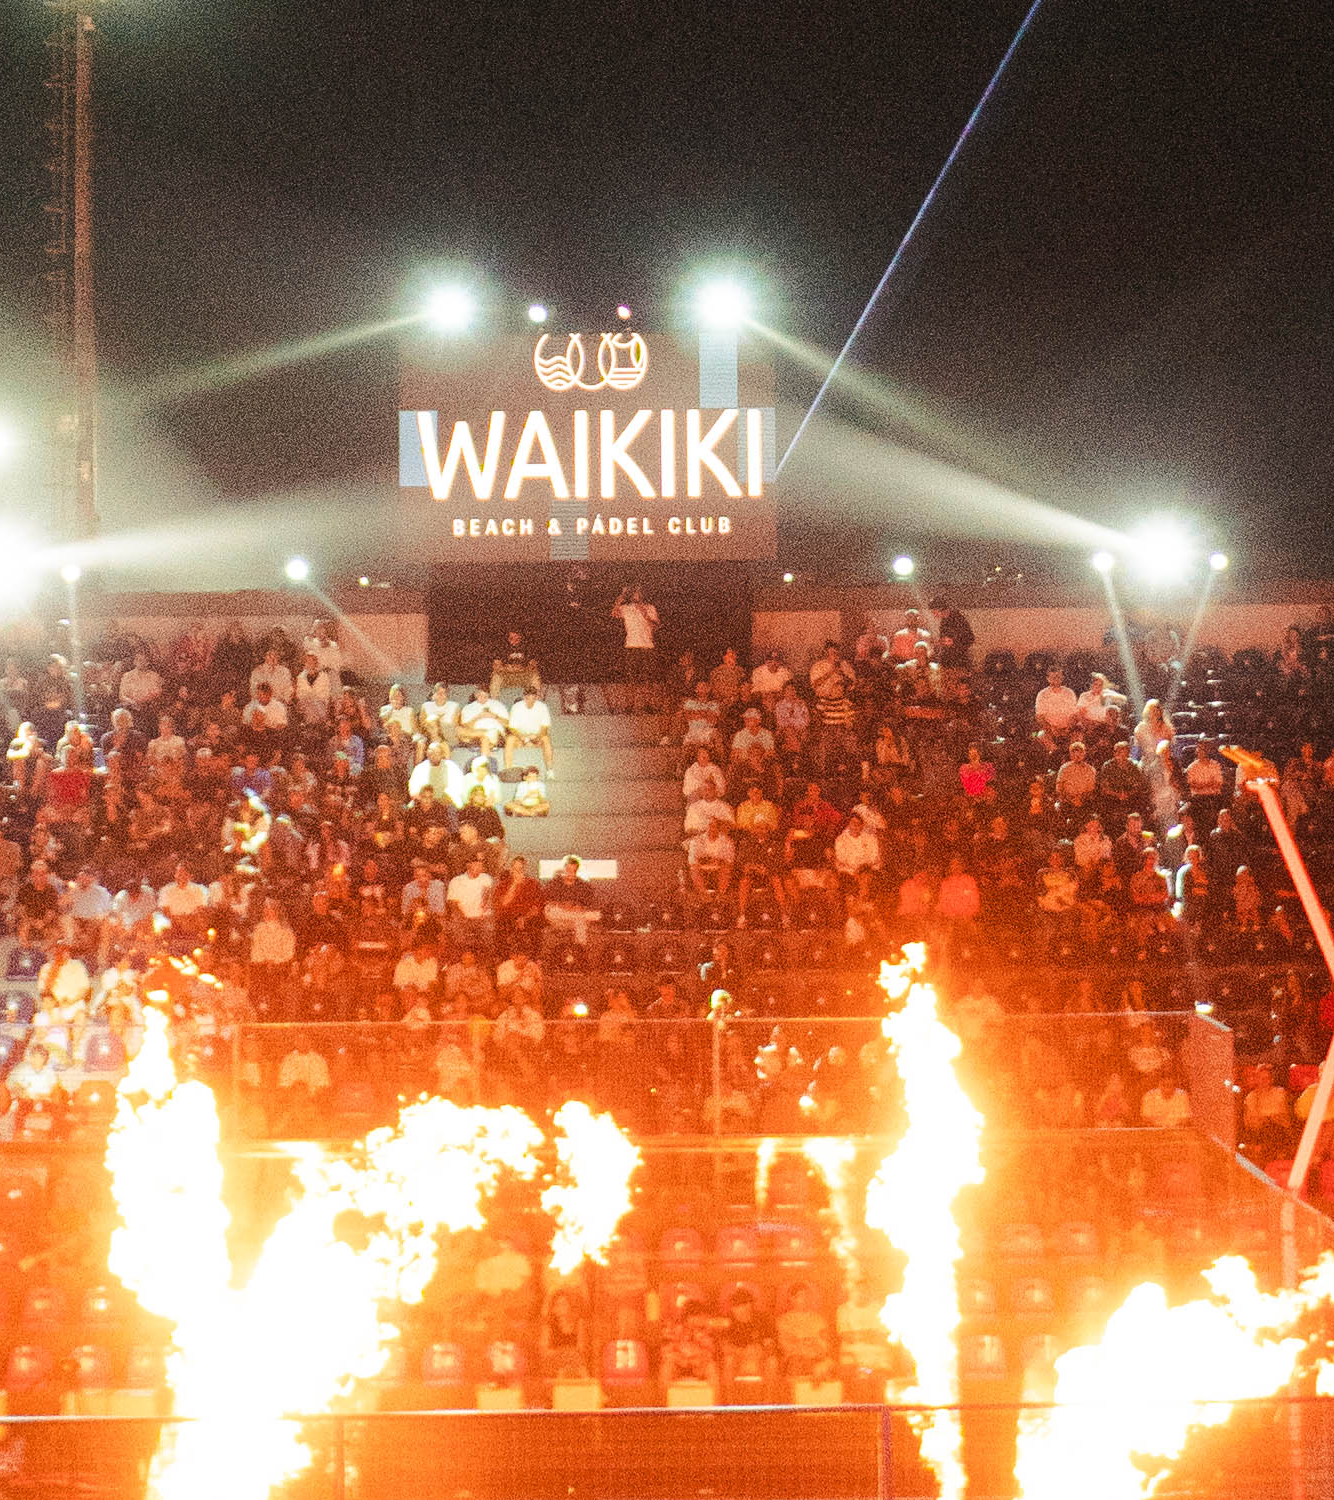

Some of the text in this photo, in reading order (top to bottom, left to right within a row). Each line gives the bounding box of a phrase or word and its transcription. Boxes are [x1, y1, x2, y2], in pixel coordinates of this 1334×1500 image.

[417, 409, 763, 501] WAIKIKI
[452, 514, 732, 537] BEACH & PÁDEL CLUB
